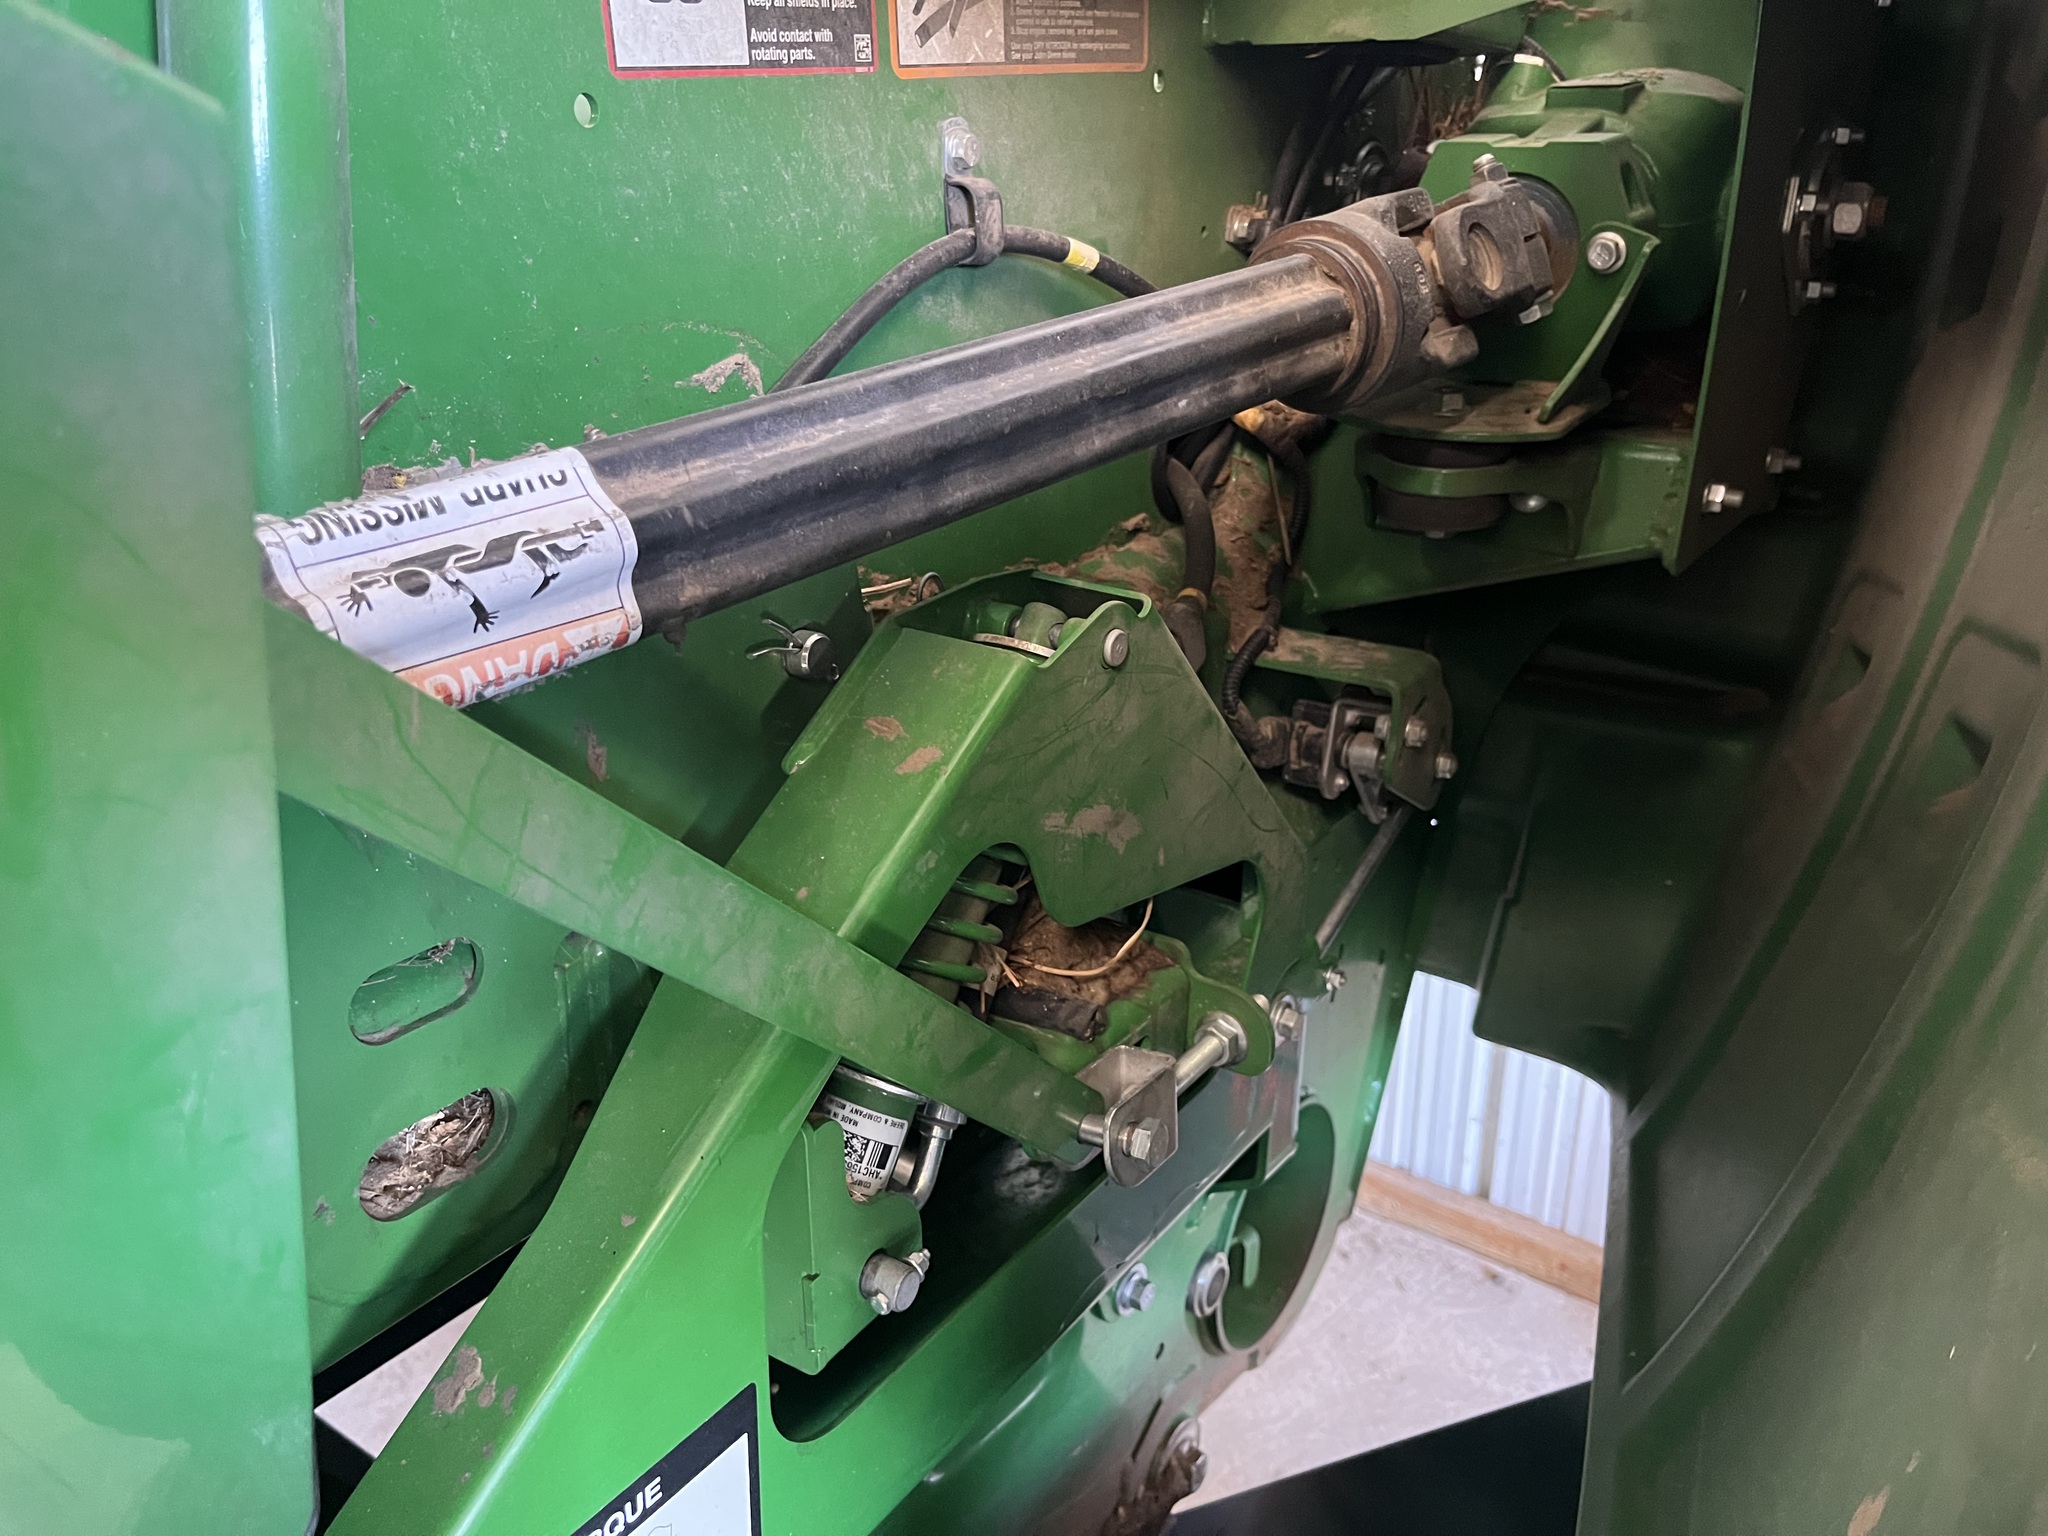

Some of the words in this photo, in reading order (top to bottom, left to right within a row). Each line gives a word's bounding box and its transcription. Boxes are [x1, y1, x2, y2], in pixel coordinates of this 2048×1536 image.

[750, 27, 778, 42] Avoid
[778, 28, 813, 43] contact
[814, 28, 834, 42] with
[751, 46, 789, 64] rotating
[789, 46, 816, 63] parts.
[423, 641, 560, 707] DANG
[831, 1111, 840, 1119] IN
[840, 1116, 859, 1128] MADE
[588, 1476, 663, 1536] QUE
